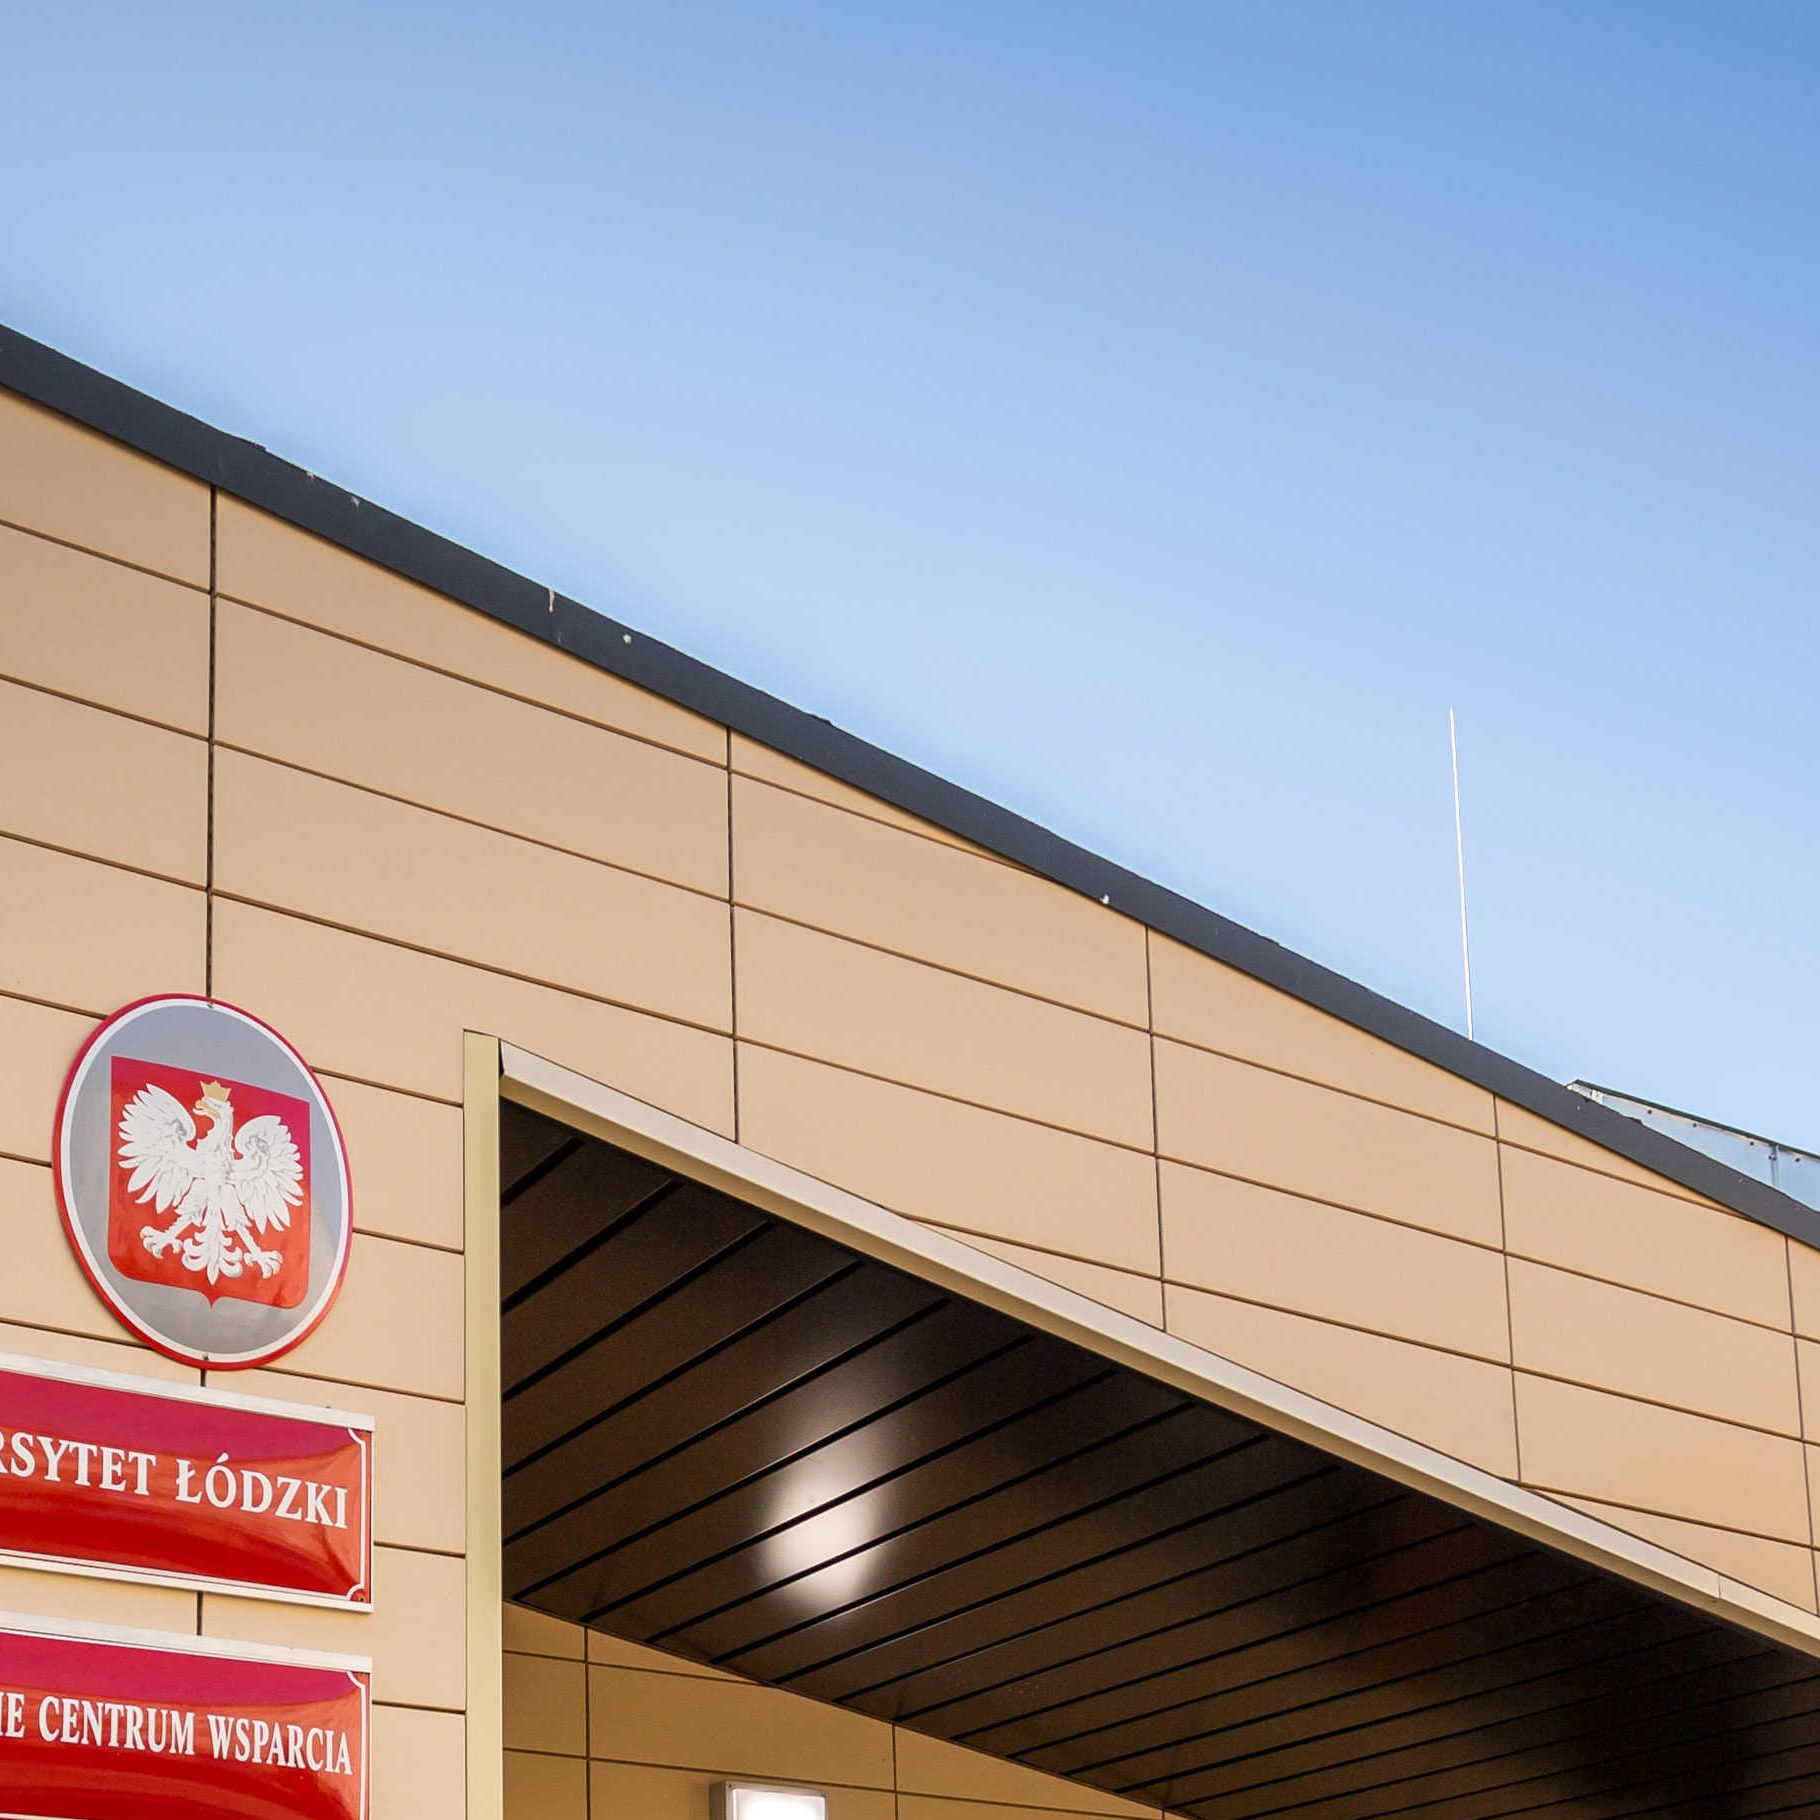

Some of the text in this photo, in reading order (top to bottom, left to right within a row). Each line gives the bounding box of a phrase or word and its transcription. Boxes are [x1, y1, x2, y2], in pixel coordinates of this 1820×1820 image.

[176, 1453, 348, 1529] ŁÓDZKI
[38, 1697, 194, 1755] CENTRUM
[207, 1715, 352, 1775] WSPARCIA
